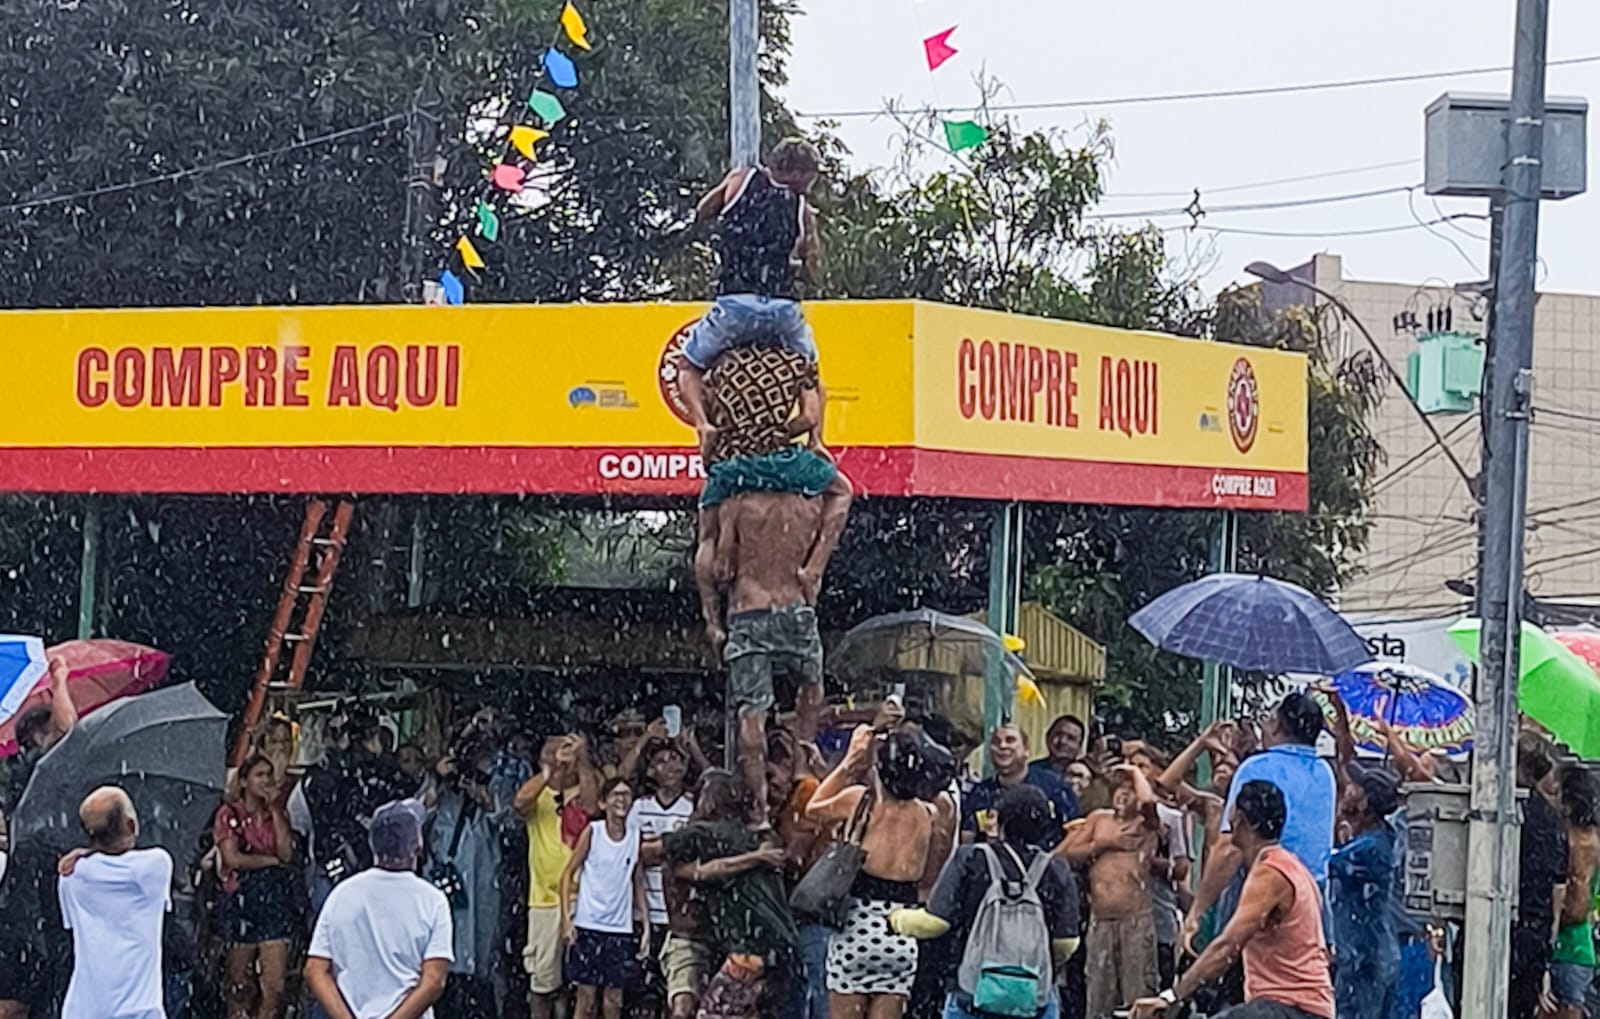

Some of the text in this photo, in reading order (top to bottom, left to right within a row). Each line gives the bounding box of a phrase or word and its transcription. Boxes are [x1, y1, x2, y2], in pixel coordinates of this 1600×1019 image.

[76, 345, 460, 412] COMPRE AQUI
[959, 338, 1078, 428] COMPRE
[1099, 356, 1158, 439] AQUI
[599, 454, 708, 478] COMPR
[1212, 474, 1252, 496] COMPRE
[1362, 632, 1405, 657] sta
